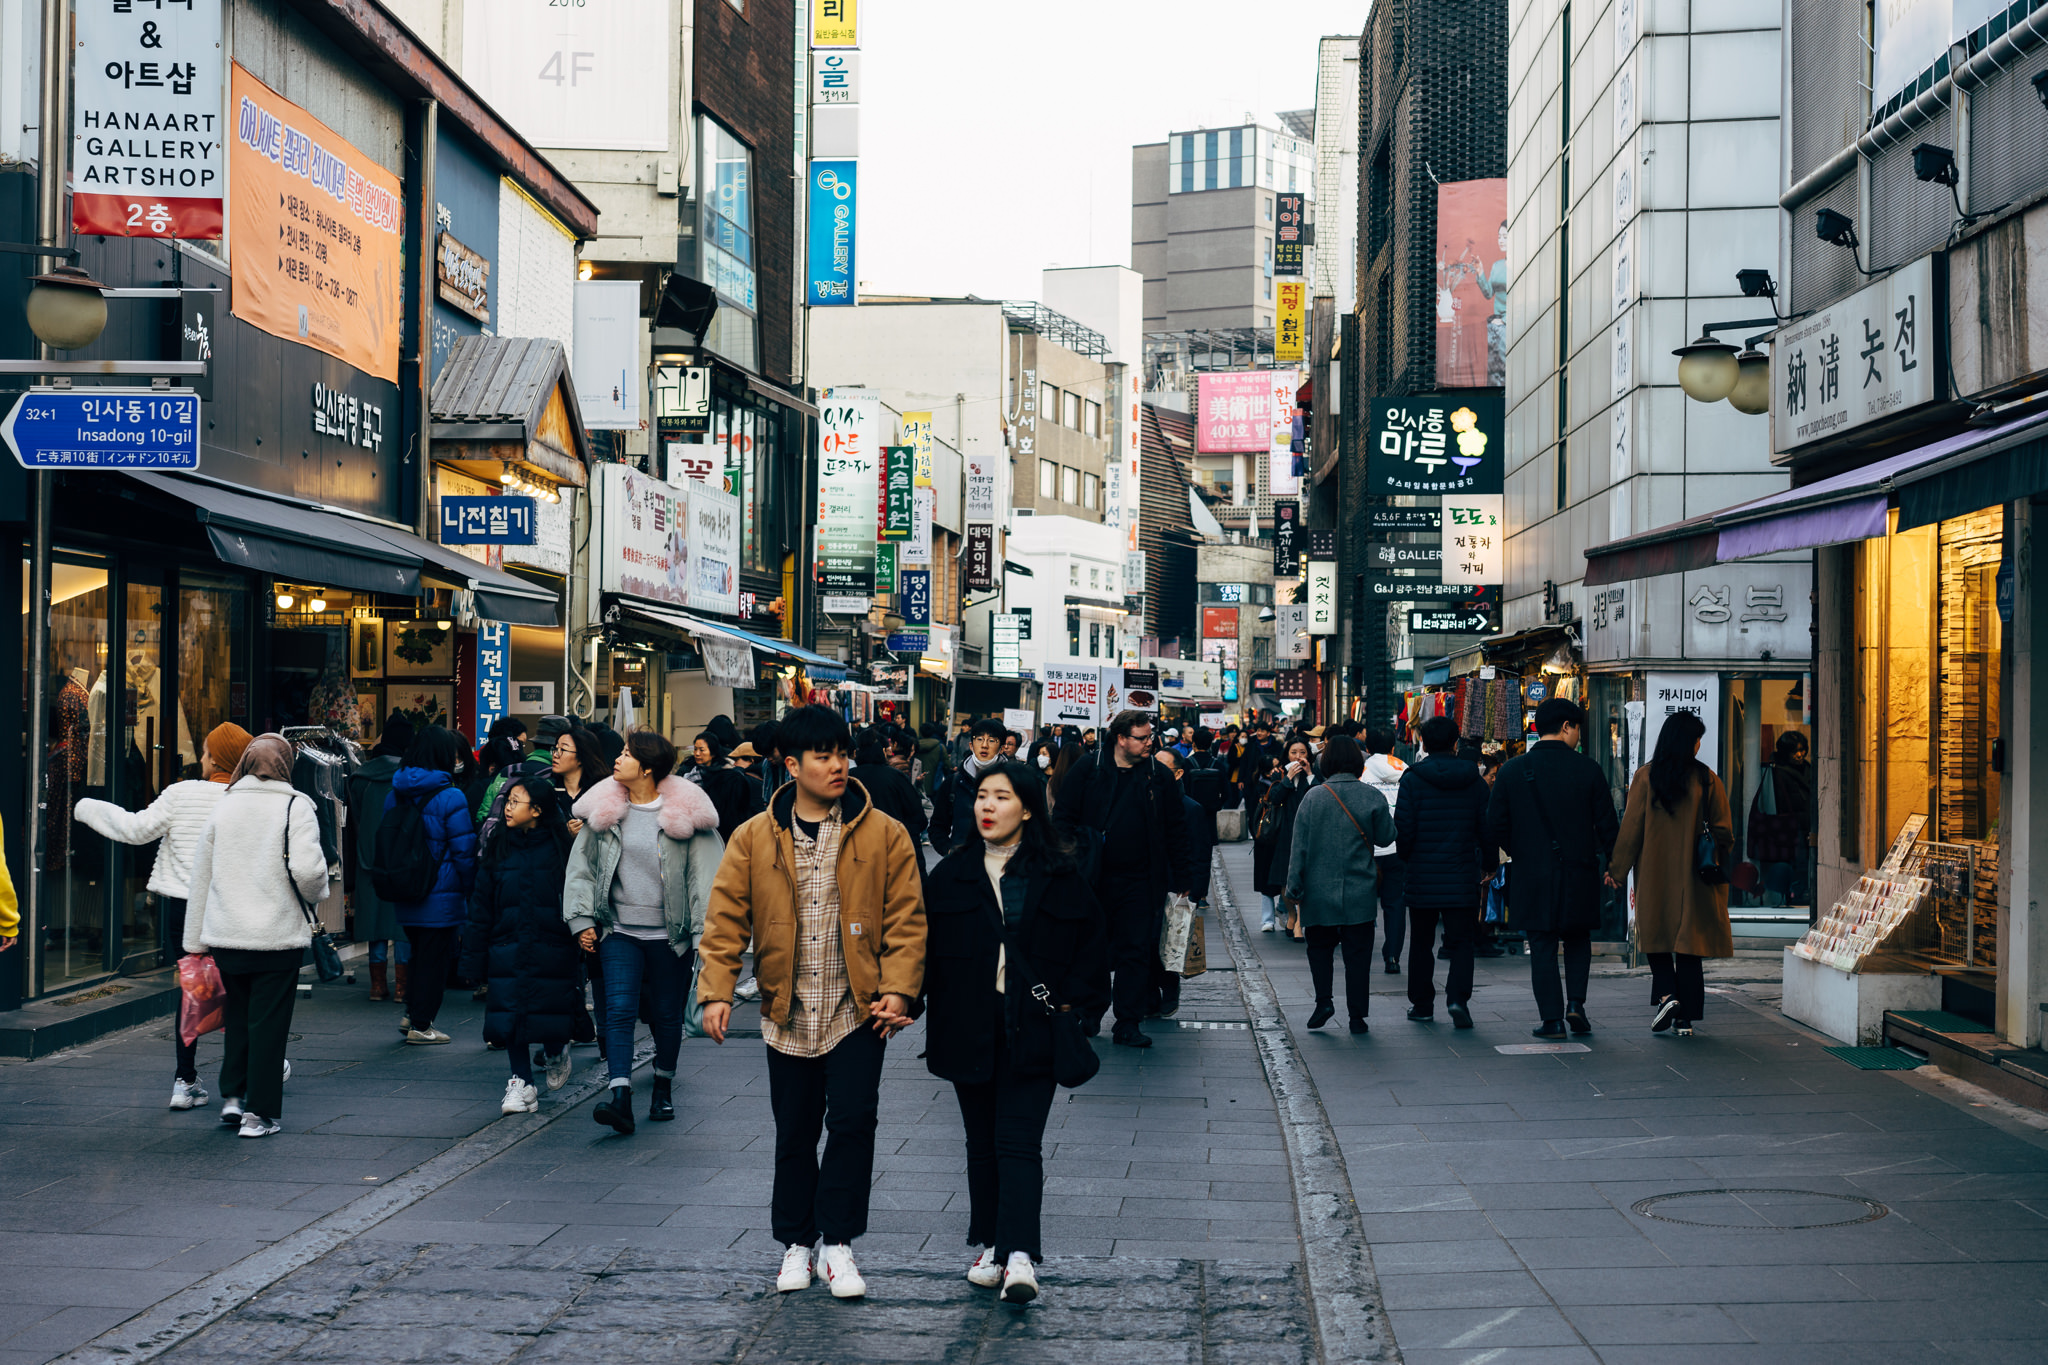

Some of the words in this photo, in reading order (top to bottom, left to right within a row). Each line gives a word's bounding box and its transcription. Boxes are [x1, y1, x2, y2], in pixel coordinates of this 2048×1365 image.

[140, 20, 163, 49] &
[815, 29, 855, 39] 일반음식점
[105, 61, 197, 95] 아트샵
[538, 50, 595, 88] 4F
[820, 90, 849, 103] 갤러리
[84, 110, 216, 133] HANAART
[86, 137, 214, 160] GALLERY
[83, 164, 215, 187] ARTSHOP
[239, 98, 282, 161] 하나아트
[283, 124, 311, 177] 갤러리
[311, 142, 346, 201] 전시대관
[346, 169, 364, 215] 특별
[364, 182, 399, 233] 할인행사
[126, 202, 173, 233] 2층
[1280, 197, 1302, 242] 가야금
[833, 205, 849, 275] GALLERY
[1860, 294, 1917, 390] 놋전
[1023, 369, 1036, 412] 갤러리
[81, 399, 193, 424] 인사동10길
[314, 381, 359, 446] 일신화랑
[362, 402, 382, 454] 표구
[823, 407, 865, 431] 인사
[1387, 407, 1445, 433] 인사동
[77, 427, 145, 445] Insadong
[150, 428, 192, 446] 10-gil
[823, 432, 862, 455] 아트
[1018, 415, 1036, 455] 서호
[35, 451, 99, 464] 仁寺洞10街
[107, 452, 191, 464] インサドン10ギル
[1380, 430, 1448, 475] 마루
[822, 458, 872, 477] 프라자
[888, 449, 912, 529] 소슬다원
[968, 485, 993, 501] 전각
[445, 505, 529, 536] 나전칠기
[829, 504, 852, 514] 갤러리
[1448, 507, 1485, 526] 도도
[969, 526, 992, 539] 대익
[1453, 535, 1492, 550] 전통차
[973, 540, 987, 576] 보이차
[1398, 550, 1443, 561] GALLER
[1468, 551, 1476, 561] 와
[1460, 563, 1484, 576] 커피
[910, 574, 928, 621] 명신당
[1373, 583, 1394, 594] G&J
[1435, 584, 1460, 595] 갤러리
[1463, 584, 1474, 594] 3F
[1688, 584, 1788, 624] 성보
[1467, 617, 1477, 625] 2F
[480, 622, 505, 733] 나전칠기
[1066, 671, 1098, 682] 보리밥과
[1047, 681, 1097, 705] 코다리전문
[1530, 687, 1546, 696] ADT
[1658, 688, 1708, 702] 캐시미어
[1064, 705, 1074, 713] TV
[1075, 706, 1091, 716] 방송
